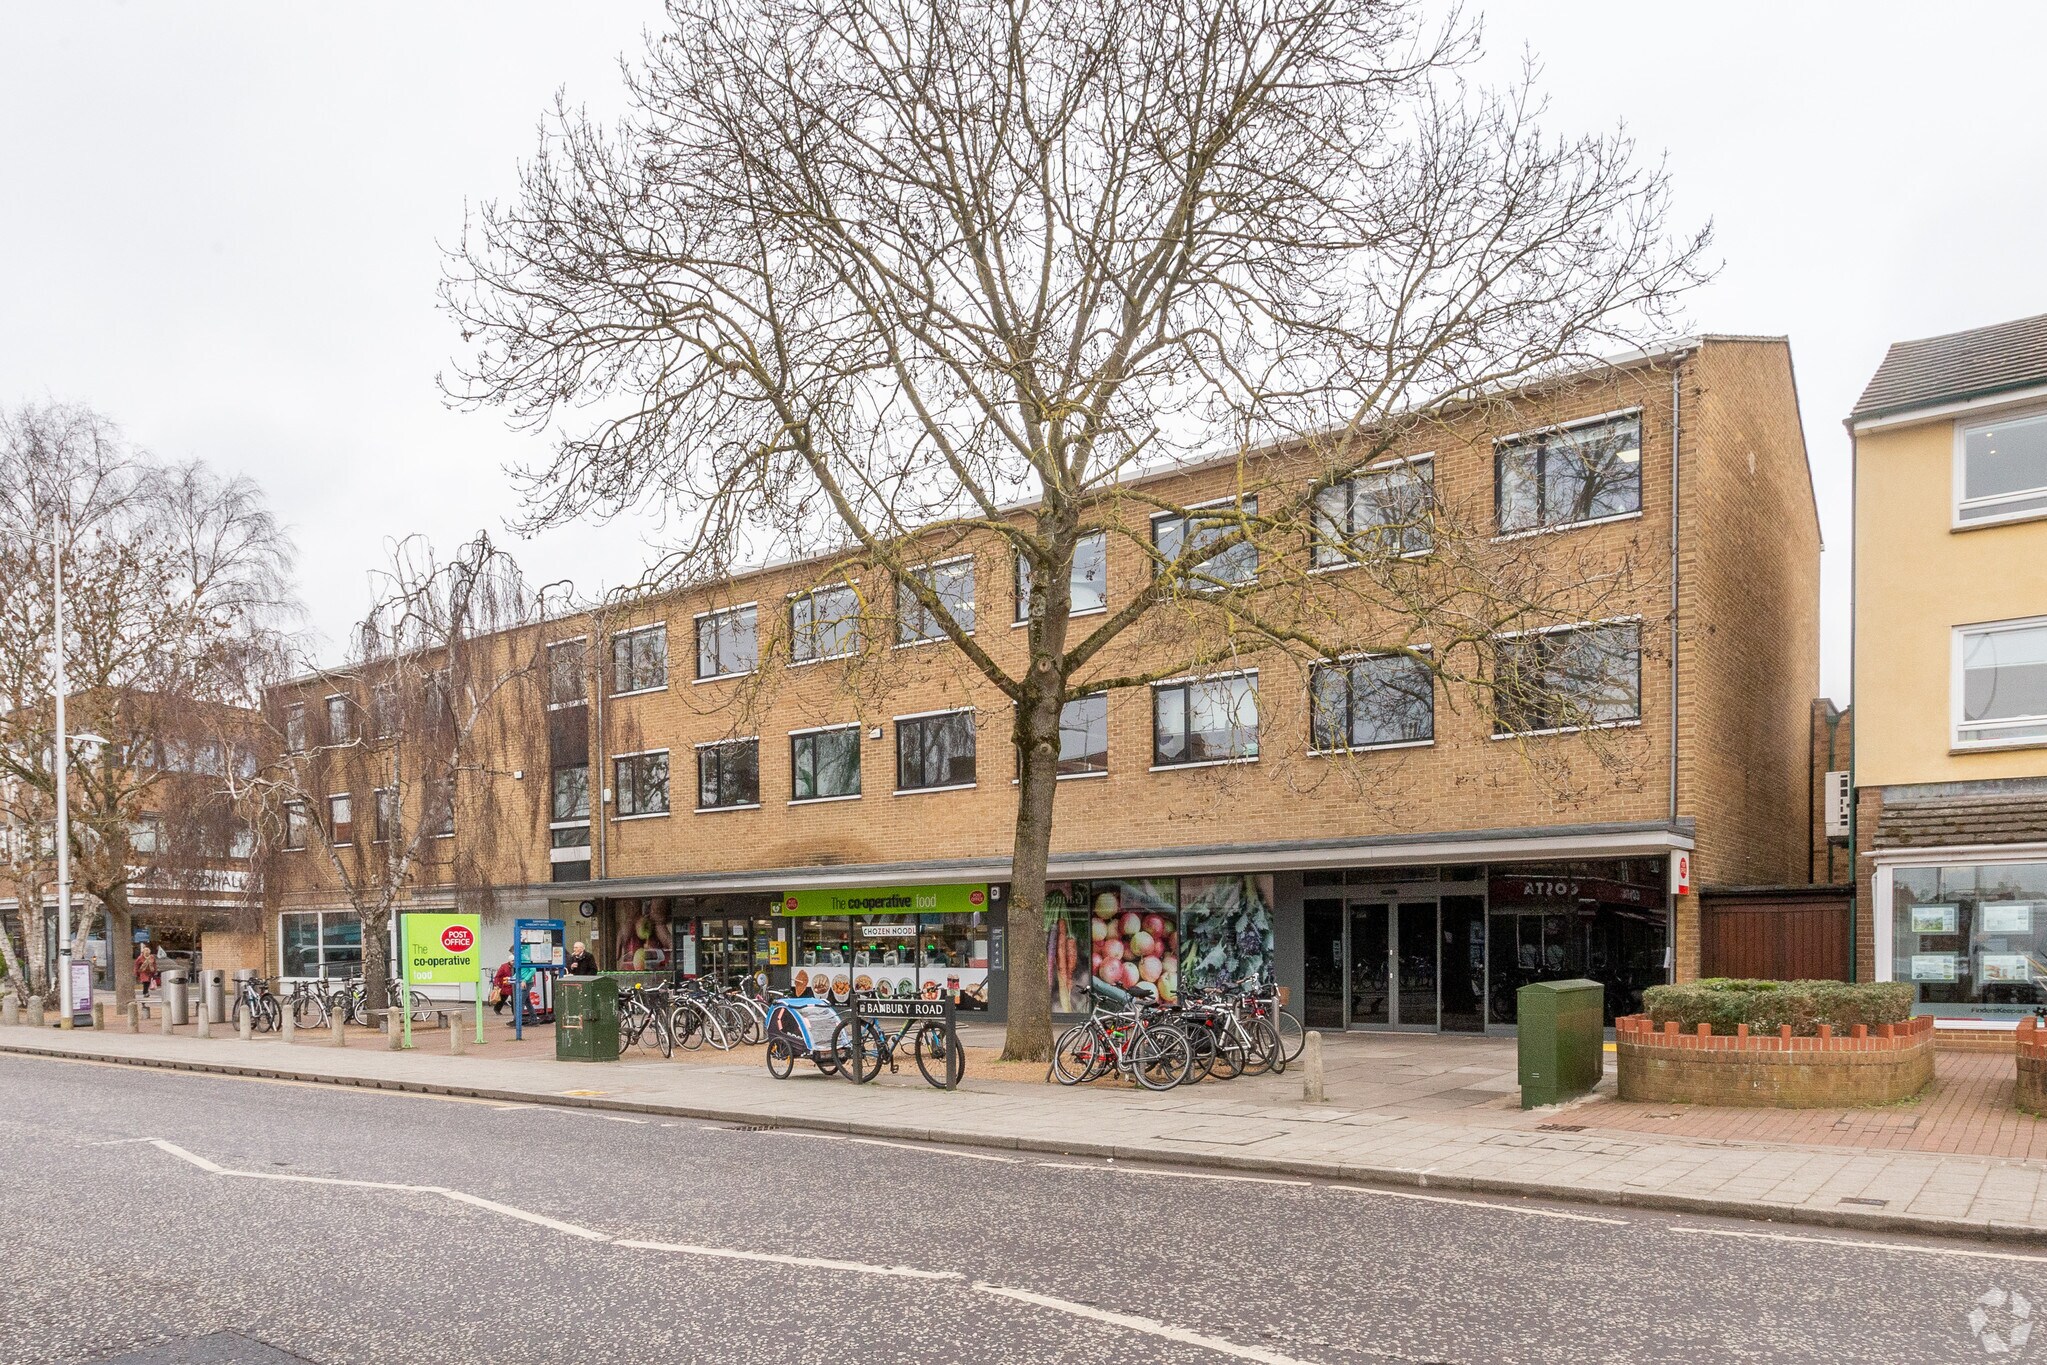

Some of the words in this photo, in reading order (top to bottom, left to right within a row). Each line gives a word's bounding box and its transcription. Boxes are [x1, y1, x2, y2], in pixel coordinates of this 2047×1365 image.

[831, 897, 846, 910] The
[848, 894, 911, 911] co-operative
[916, 893, 936, 908] food
[444, 938, 470, 946] OFFICE
[412, 943, 428, 954] The
[413, 955, 471, 968] co-operative
[413, 970, 432, 980] food
[867, 1003, 911, 1014] BANBURY
[915, 1004, 943, 1015] ROAD
